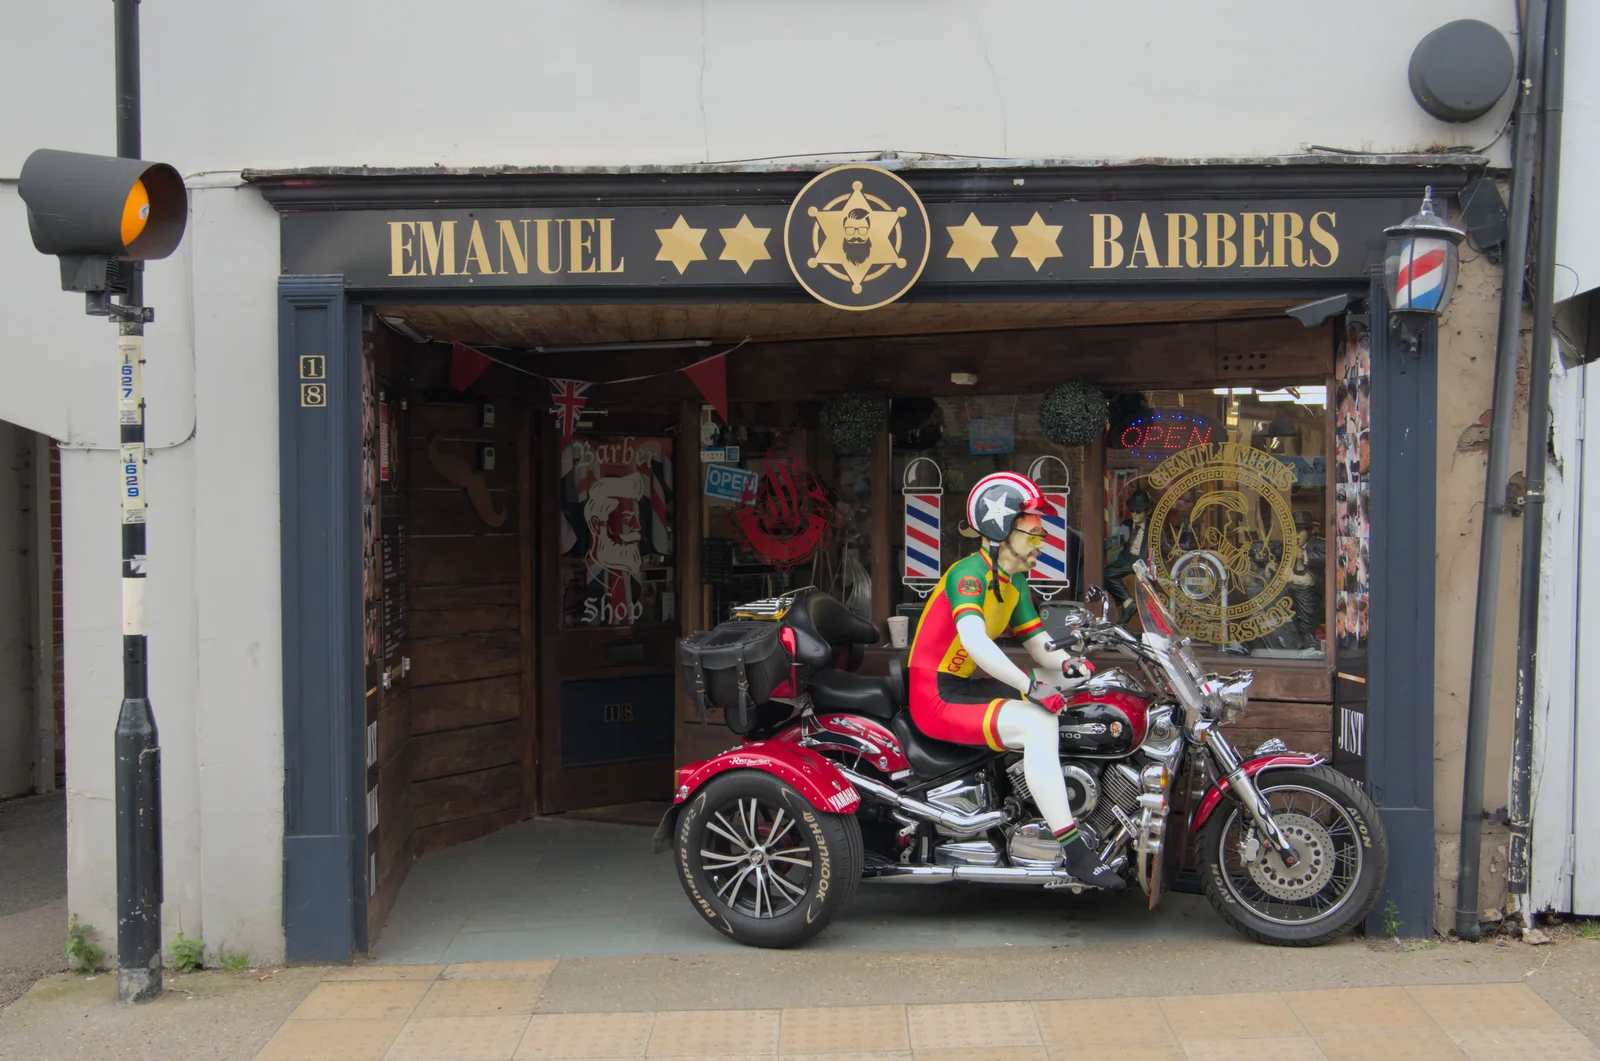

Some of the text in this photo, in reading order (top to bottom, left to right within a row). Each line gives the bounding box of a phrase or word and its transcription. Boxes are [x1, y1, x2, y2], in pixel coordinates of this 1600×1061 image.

[387, 210, 1339, 277] EMANUEL BARBERS
[121, 354, 133, 398] 1627
[575, 437, 657, 468] Barber
[1121, 425, 1212, 449] OPEN
[125, 453, 140, 498] 1629
[709, 469, 755, 493] OPEN
[1148, 442, 1298, 492] GENTLEMEN'S
[580, 593, 643, 625] Shop
[947, 645, 969, 673] GOD
[608, 704, 634, 721] 18
[1338, 707, 1364, 756] JUST
[827, 787, 859, 813] YAMAHA
[1346, 806, 1373, 849] AVON
[680, 850, 717, 919] Dynapro
[1210, 863, 1236, 904] AVON
